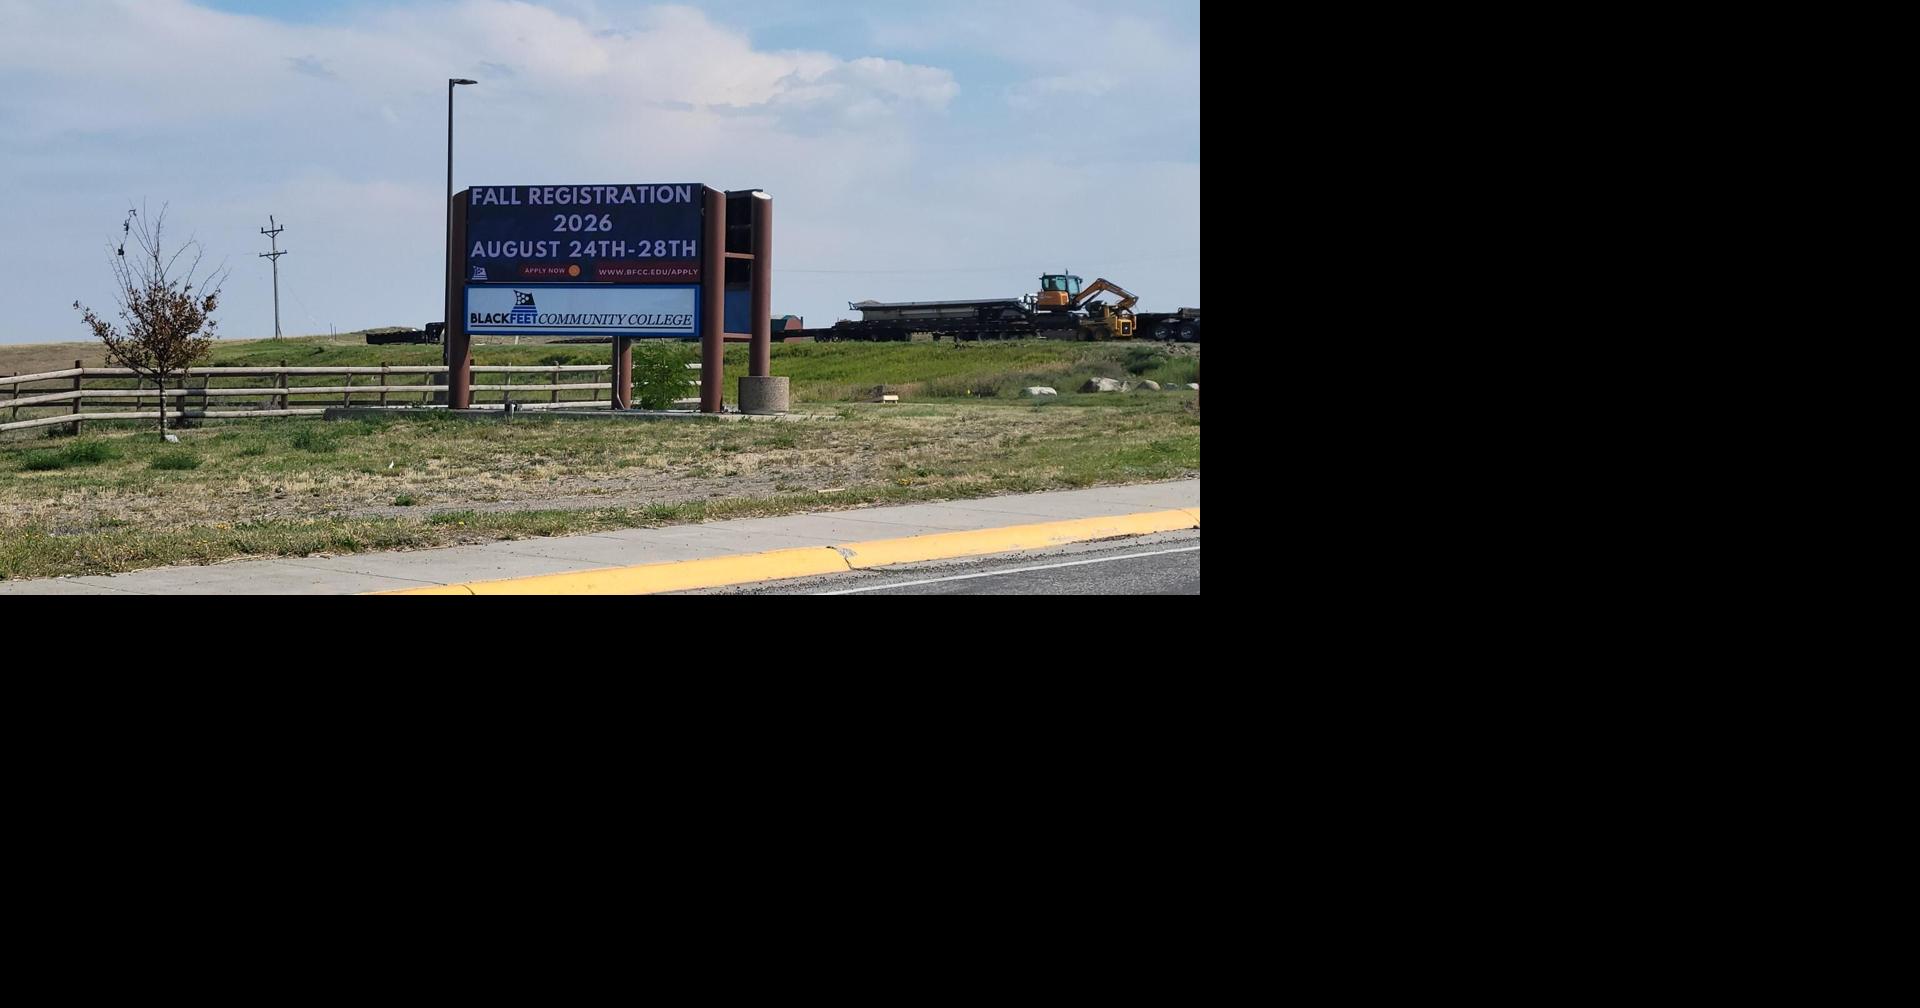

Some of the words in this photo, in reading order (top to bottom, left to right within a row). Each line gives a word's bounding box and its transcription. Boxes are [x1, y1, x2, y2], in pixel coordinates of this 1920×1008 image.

[472, 187, 521, 205] FALL
[528, 185, 691, 205] REGISTRATION
[553, 214, 613, 232] 2026
[470, 240, 560, 258] AUGUST
[568, 239, 697, 258] 24TH-28TH
[598, 268, 699, 277] WWW.BFCC.EDU/APPLY
[470, 312, 538, 324] BLACKFEET
[538, 313, 627, 326] COMMUNITY
[628, 313, 693, 326] COLLEGE
